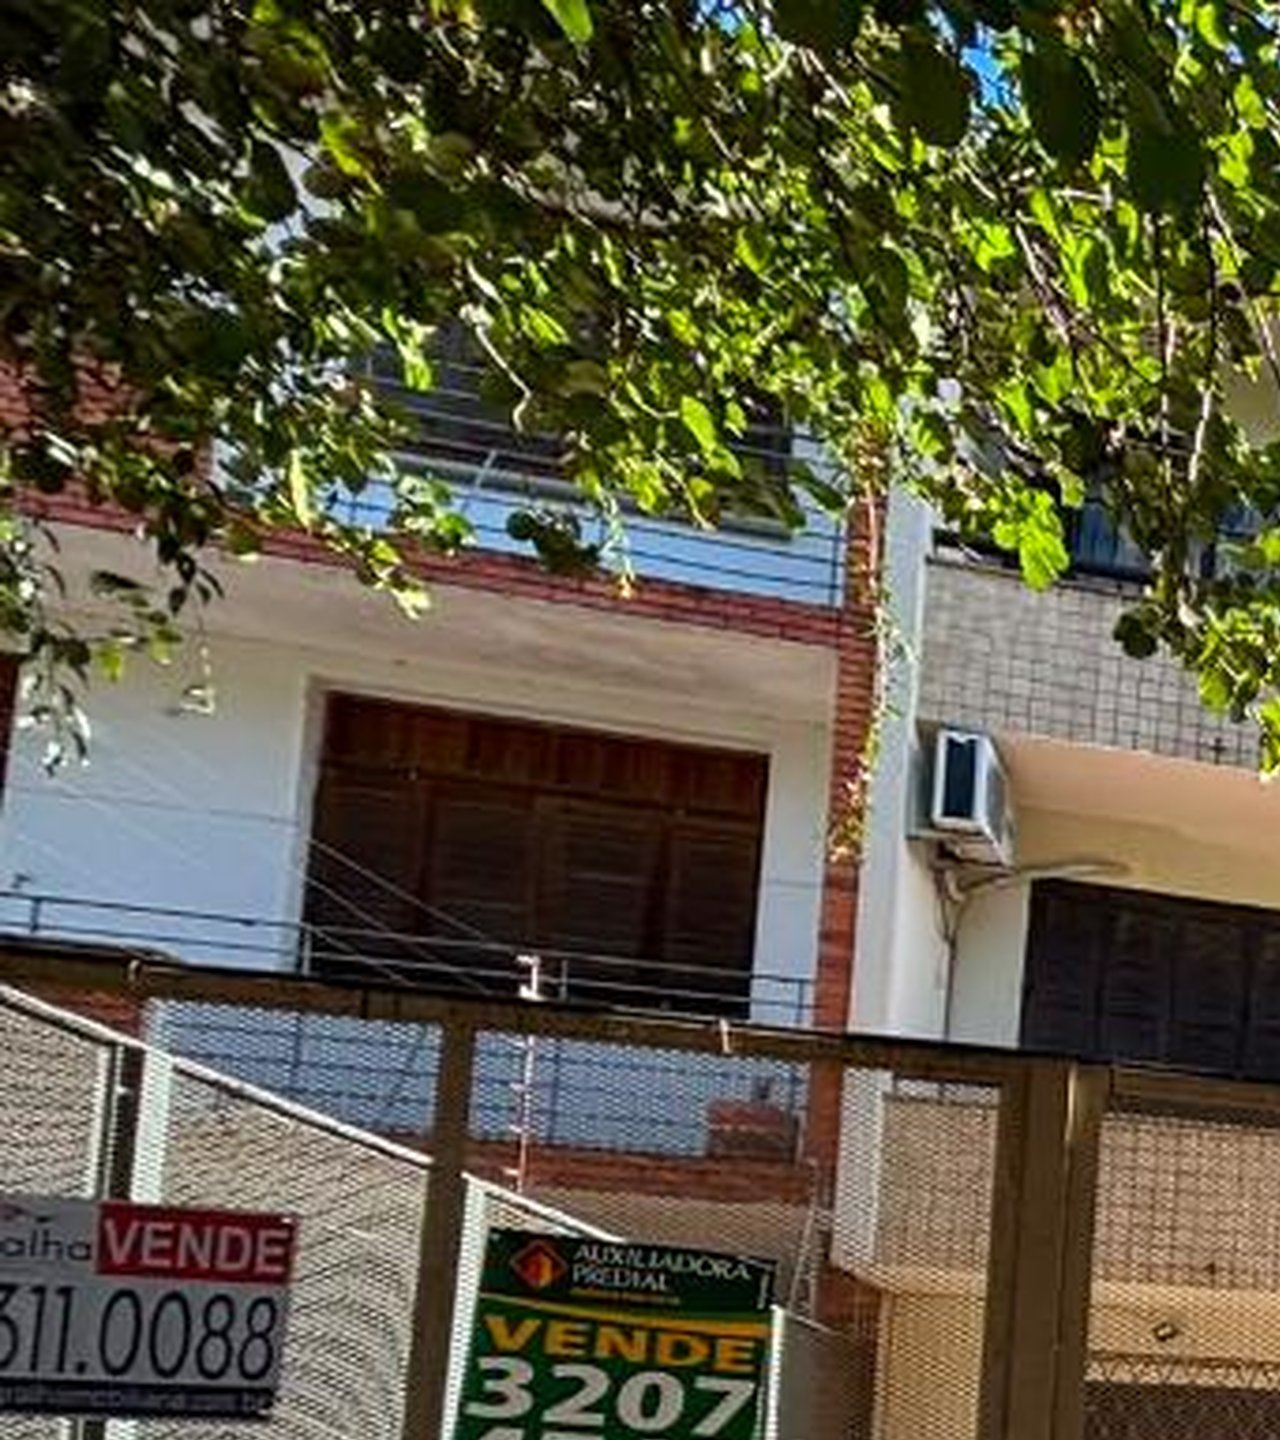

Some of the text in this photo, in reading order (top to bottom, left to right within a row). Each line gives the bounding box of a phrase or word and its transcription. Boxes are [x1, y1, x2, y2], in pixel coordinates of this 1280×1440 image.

[105, 1219, 291, 1274] VENDE
[573, 1244, 751, 1280] AUXILIADORA
[572, 1265, 668, 1291] PREDIAL
[484, 1315, 756, 1373] VENDE
[464, 1356, 756, 1437] 3207
